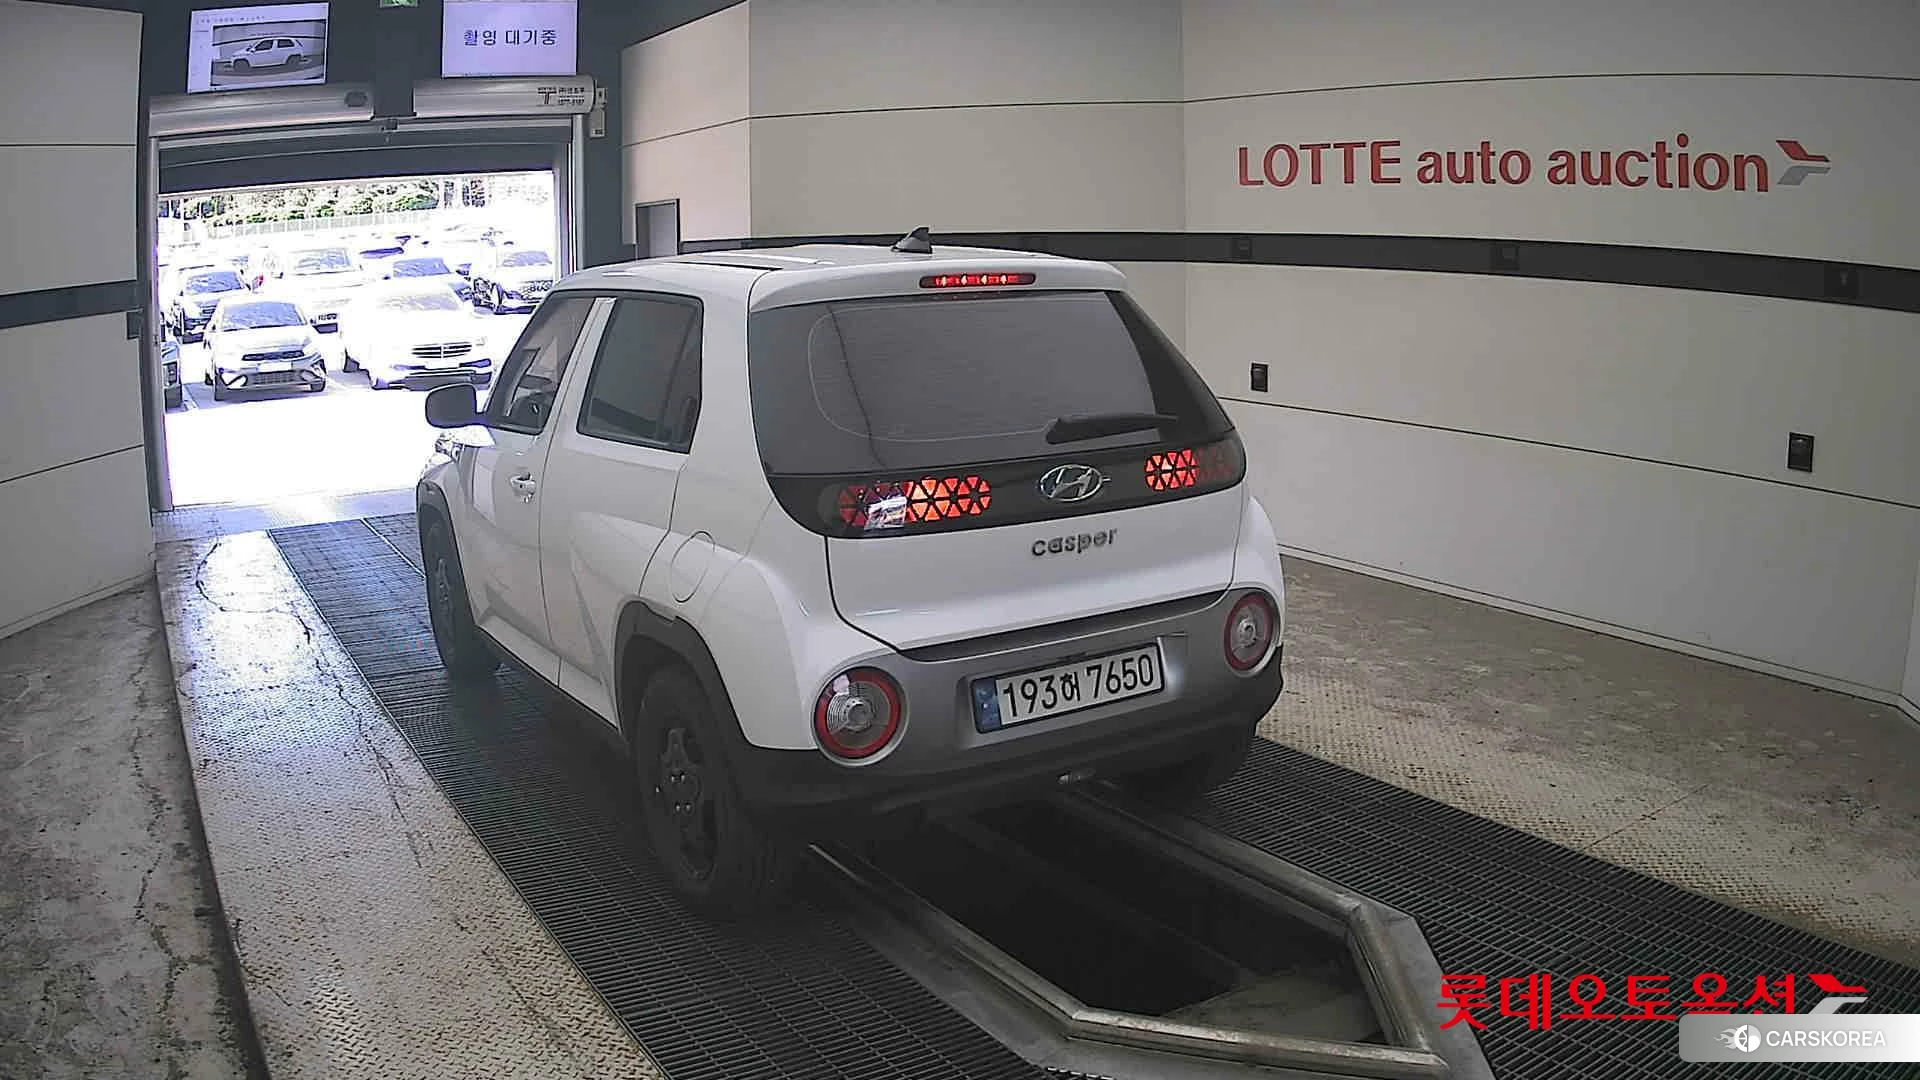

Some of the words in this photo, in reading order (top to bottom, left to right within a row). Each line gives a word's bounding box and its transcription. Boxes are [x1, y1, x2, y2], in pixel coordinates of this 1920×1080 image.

[464, 29, 497, 47] 촬영
[505, 29, 557, 46] 대기중
[1238, 139, 1401, 188] LOTTE
[1417, 141, 1532, 185] auto
[1547, 133, 1770, 193] auction
[1031, 528, 1118, 557] casper
[1003, 671, 1081, 718] 193허
[1086, 654, 1154, 699] 7650
